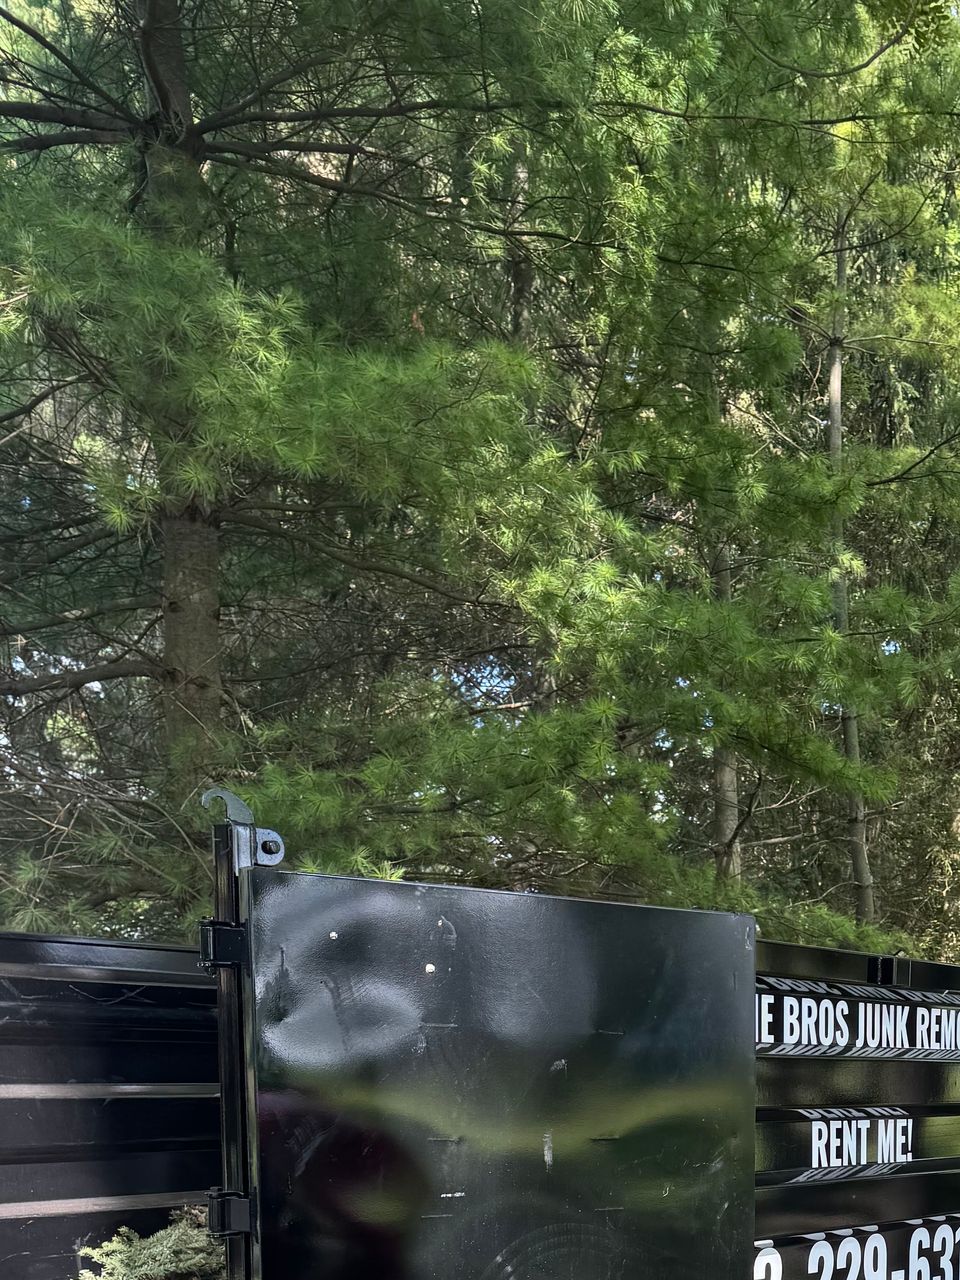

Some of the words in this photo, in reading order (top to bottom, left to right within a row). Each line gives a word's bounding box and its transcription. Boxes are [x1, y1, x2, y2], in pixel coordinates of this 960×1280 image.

[783, 996, 850, 1047] BROS
[855, 1002, 910, 1048] JUNK
[811, 1120, 871, 1168] RENT
[877, 1118, 913, 1164] ME!
